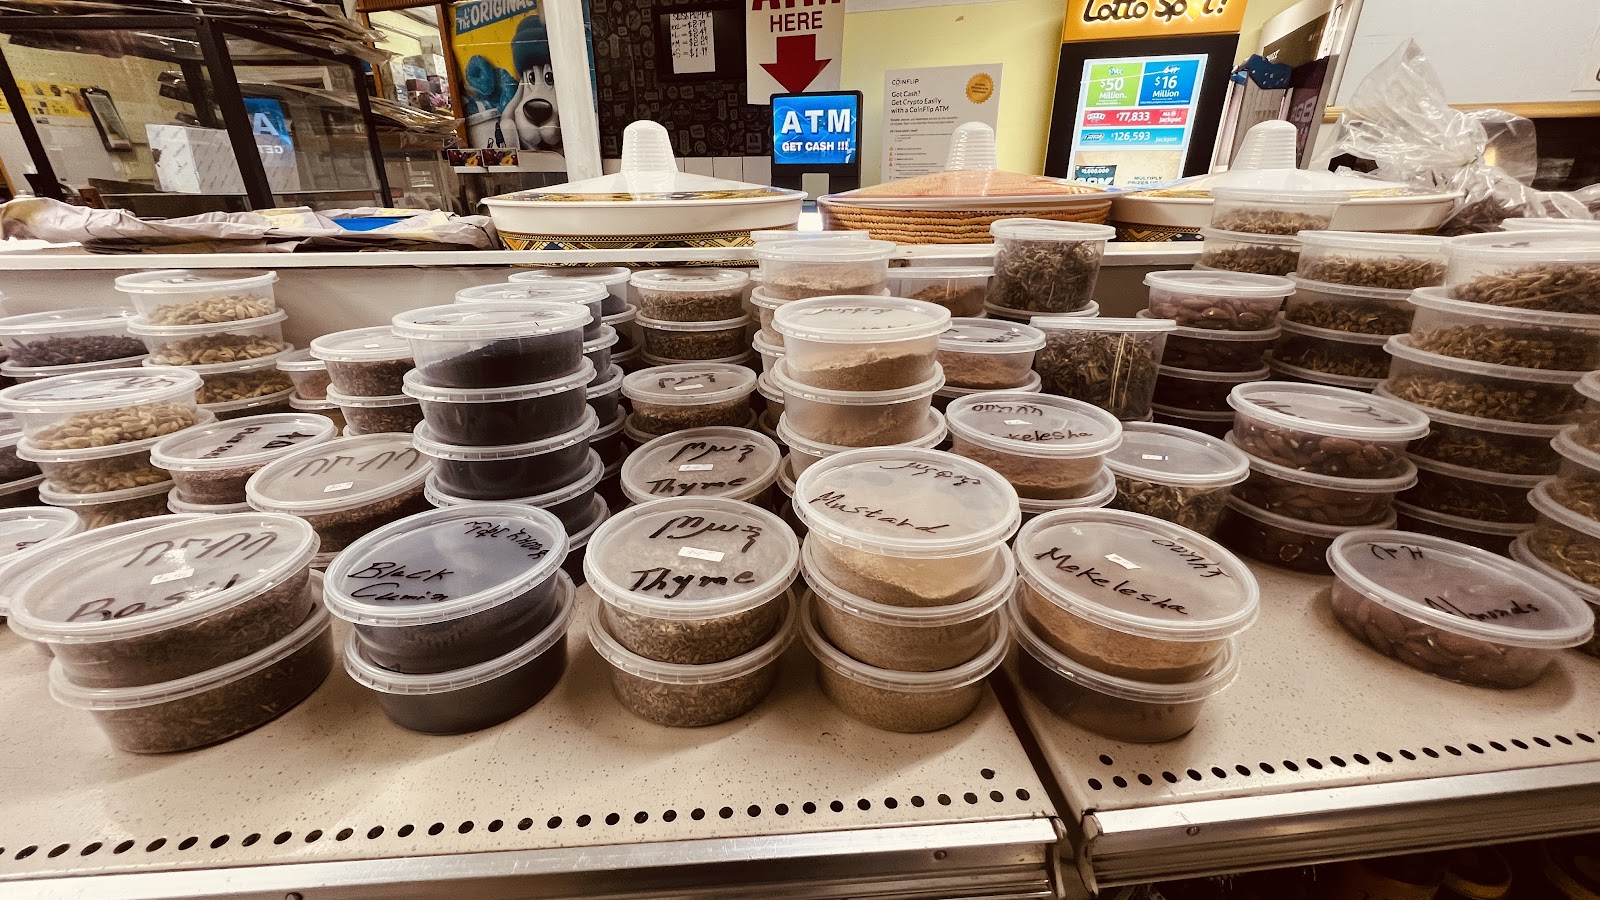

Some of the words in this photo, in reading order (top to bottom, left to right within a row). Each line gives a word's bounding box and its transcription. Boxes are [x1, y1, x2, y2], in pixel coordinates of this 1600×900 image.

[1083, 0, 1149, 22] Lotto
[770, 10, 822, 32] HERE
[1100, 78, 1124, 92] $50
[1154, 76, 1178, 89] $16
[903, 98, 924, 106] Crypto
[1152, 89, 1180, 98] Million
[910, 106, 934, 114] CoinFlip
[1116, 111, 1150, 123] $77,833
[781, 108, 851, 134] ATM
[782, 141, 803, 152] GET
[805, 141, 835, 151] CASH
[1111, 132, 1150, 142] $126,593
[647, 478, 747, 497] Thyme
[808, 490, 950, 534] Mustard
[348, 562, 454, 581] Black
[1034, 546, 1188, 615] Mekelesha
[350, 582, 448, 601] Cumin
[628, 567, 755, 599] Thyme
